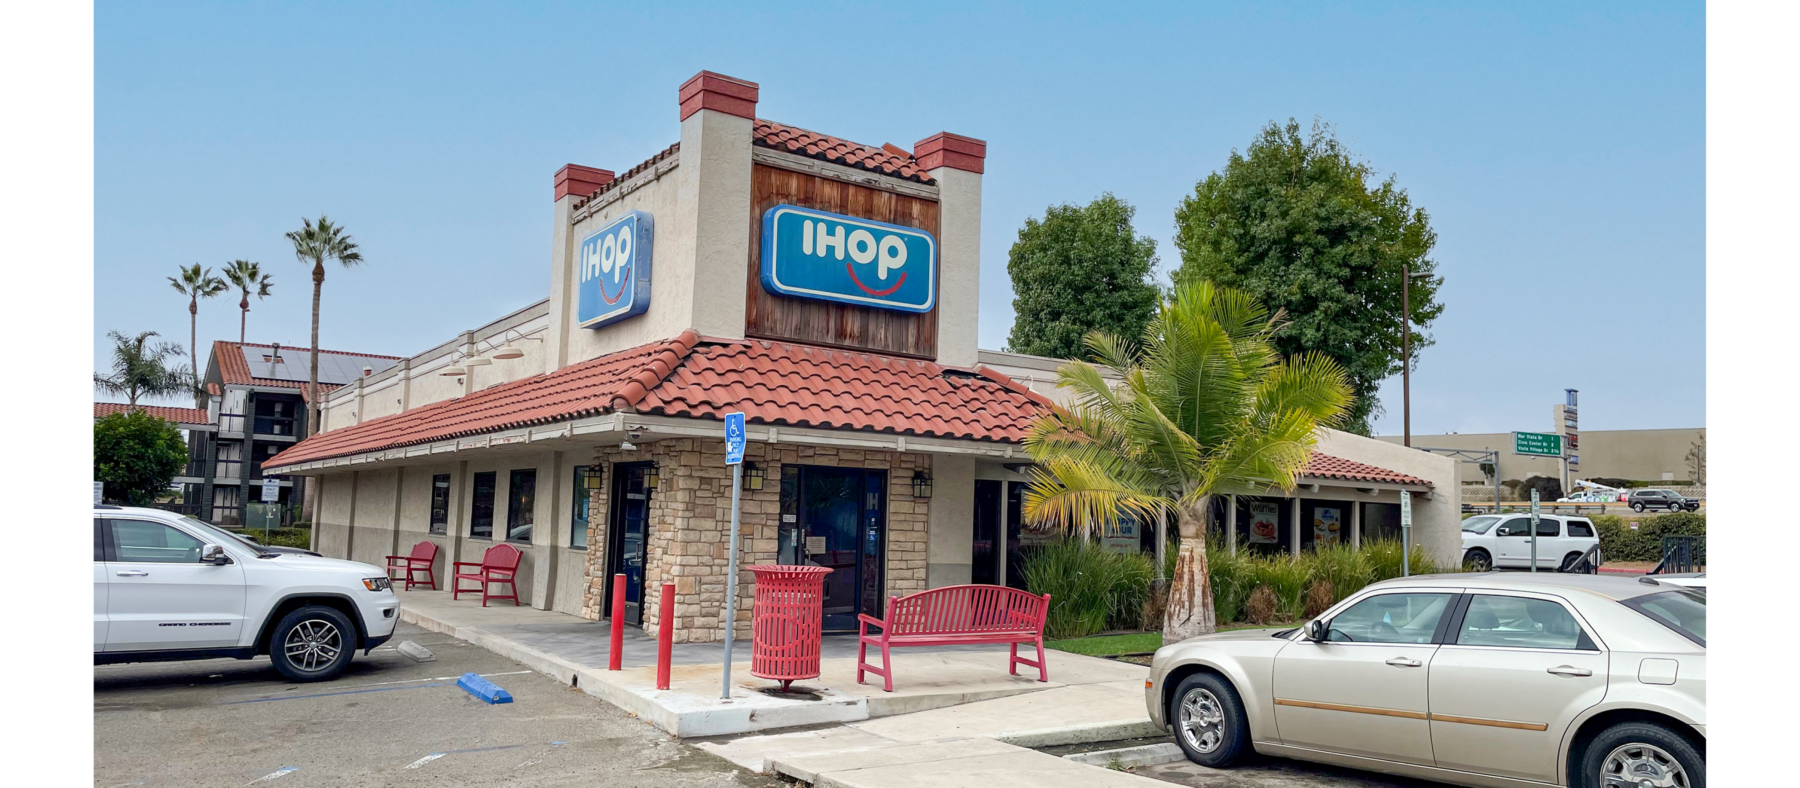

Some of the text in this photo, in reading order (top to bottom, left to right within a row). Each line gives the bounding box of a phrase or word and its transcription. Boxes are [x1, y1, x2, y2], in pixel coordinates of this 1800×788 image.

[582, 225, 632, 284] IHOP
[802, 219, 908, 280] IHOP
[1251, 503, 1277, 514] Waffles
